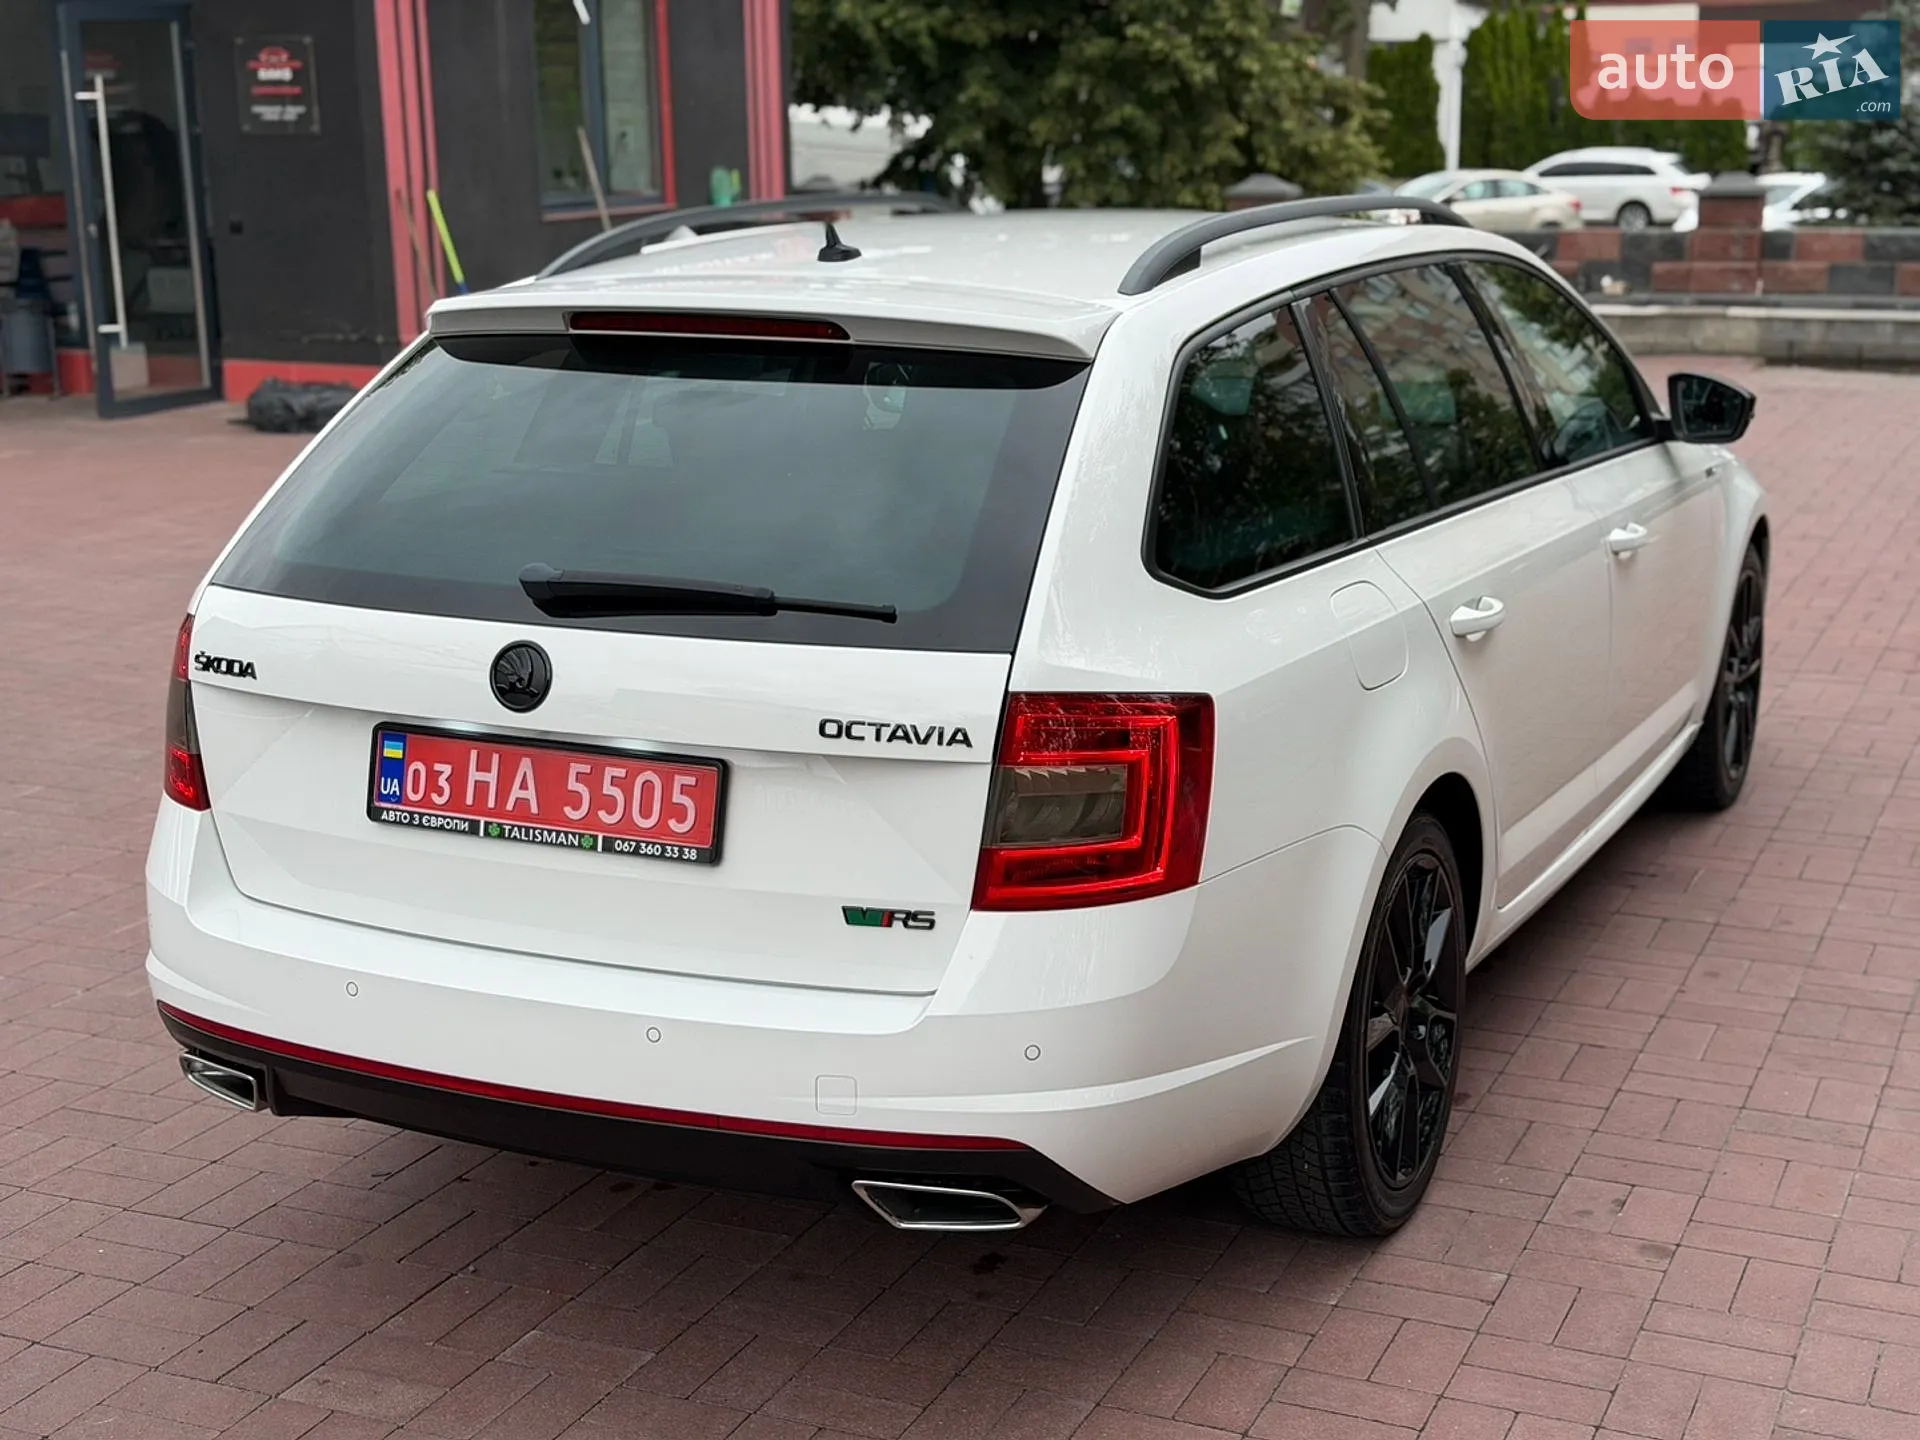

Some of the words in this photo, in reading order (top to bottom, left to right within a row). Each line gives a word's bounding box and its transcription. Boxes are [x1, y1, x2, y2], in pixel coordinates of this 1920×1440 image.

[194, 650, 257, 680] ŠKODA
[818, 718, 973, 748] OCTAVIA
[380, 776, 400, 797] UA
[406, 760, 453, 806] 03
[563, 762, 697, 834] 5505
[381, 810, 410, 823] АВТО
[422, 815, 469, 832] ЄВРОПИ
[503, 825, 579, 847] TALISMAN
[614, 840, 635, 853] 067
[639, 842, 661, 856] 360
[665, 847, 679, 858] 33
[682, 848, 698, 861] 38
